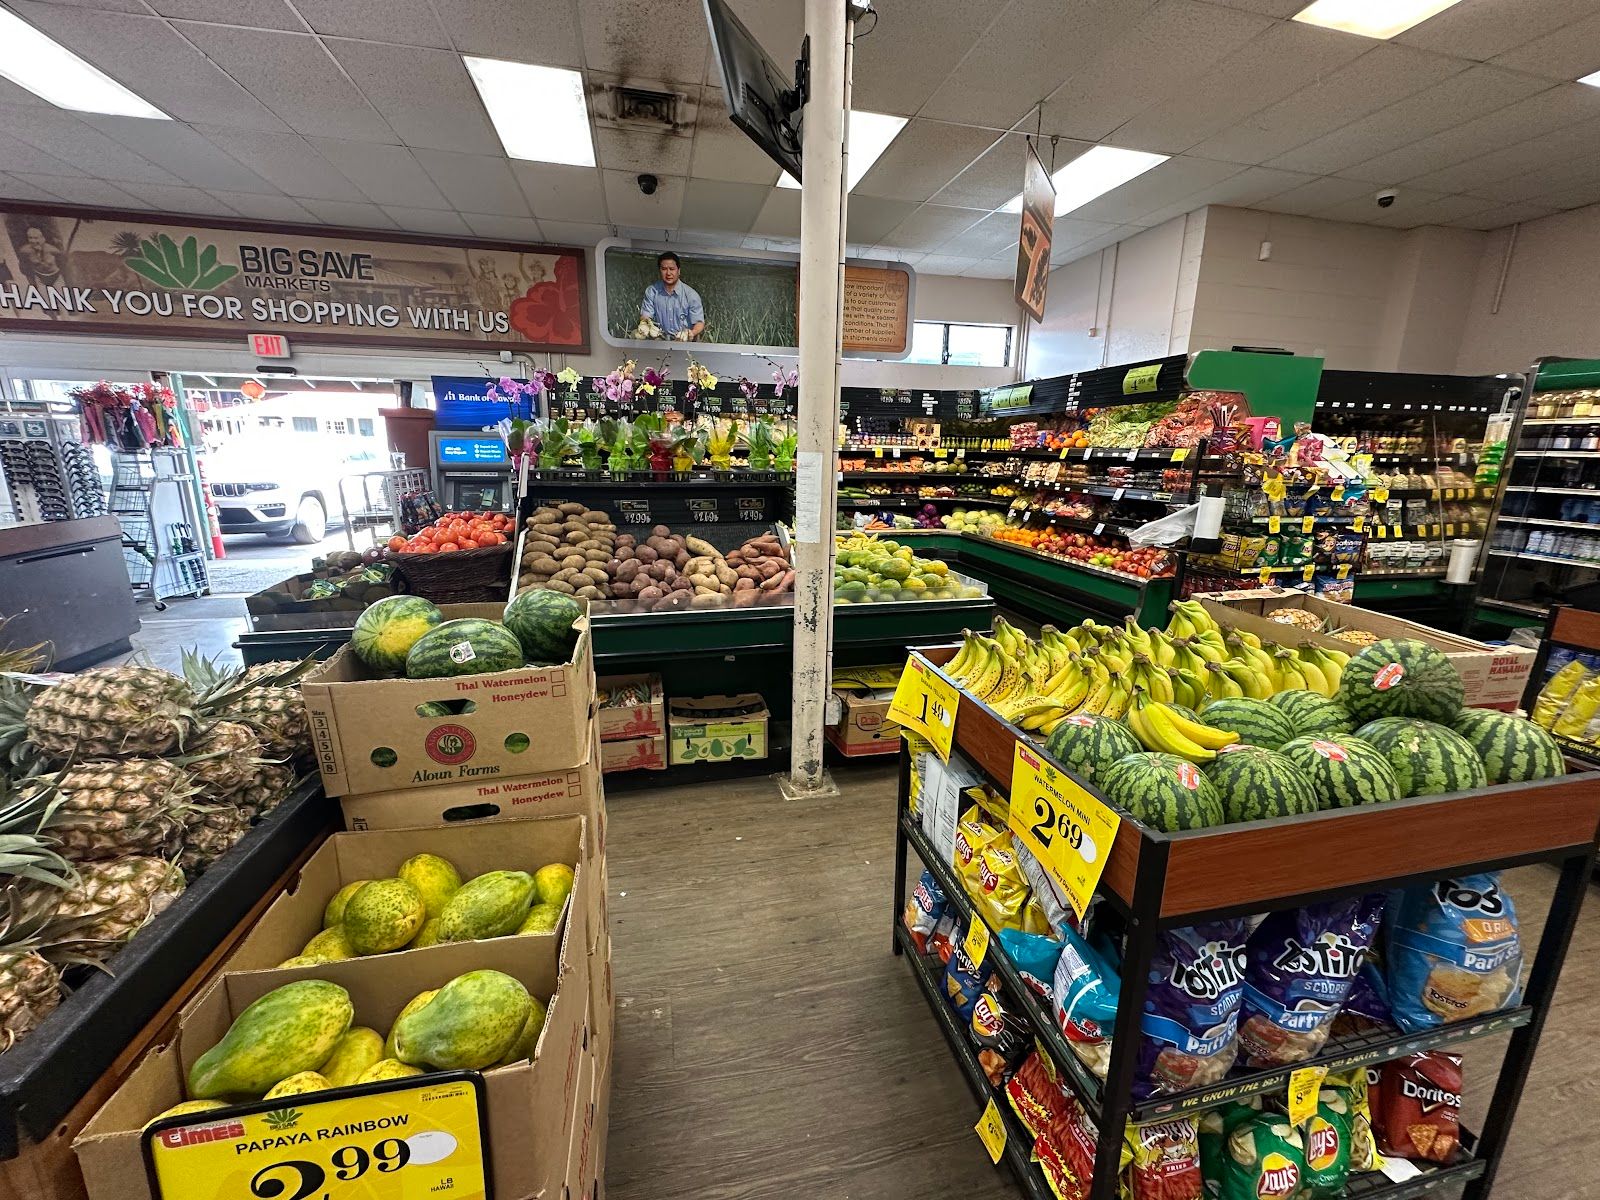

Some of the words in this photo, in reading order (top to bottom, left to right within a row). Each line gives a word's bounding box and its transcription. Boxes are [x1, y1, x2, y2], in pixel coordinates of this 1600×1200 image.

[239, 245, 293, 276] BIG
[299, 249, 375, 281] SAVE
[244, 275, 331, 293] MARKETS
[102, 289, 174, 317] YOU
[182, 294, 244, 321] FOR
[251, 297, 400, 328] SHOPPING
[406, 306, 471, 331] WITH
[478, 312, 510, 334] US
[254, 335, 282, 356] EXIT
[459, 394, 480, 402] Bank
[1492, 656, 1520, 666] ROYAL
[482, 675, 548, 688] Watermelon
[491, 689, 549, 703] Honeydew
[317, 719, 324, 727] 3
[319, 730, 327, 739] 4
[321, 742, 329, 750] 5
[323, 753, 332, 762] 6
[326, 764, 334, 773] 8
[411, 769, 453, 784] Aloun
[458, 764, 501, 778] Farms
[502, 776, 564, 793] Watermelon
[511, 790, 565, 806] Honeydew
[1033, 774, 1077, 814] WATERMELON
[1075, 807, 1091, 827] MINI
[974, 996, 1003, 1031] Lay's
[1186, 1033, 1229, 1055] Party
[1181, 1097, 1200, 1108] WE
[1202, 1086, 1236, 1103] GROW
[1239, 1081, 1260, 1093] THE
[1262, 1074, 1286, 1087] BEST
[1403, 1079, 1461, 1108] Doritos
[235, 1132, 313, 1155] PAPAYA
[316, 1114, 409, 1141] RAINBOW
[440, 1177, 454, 1186] LB
[1259, 1164, 1298, 1196] Lay's
